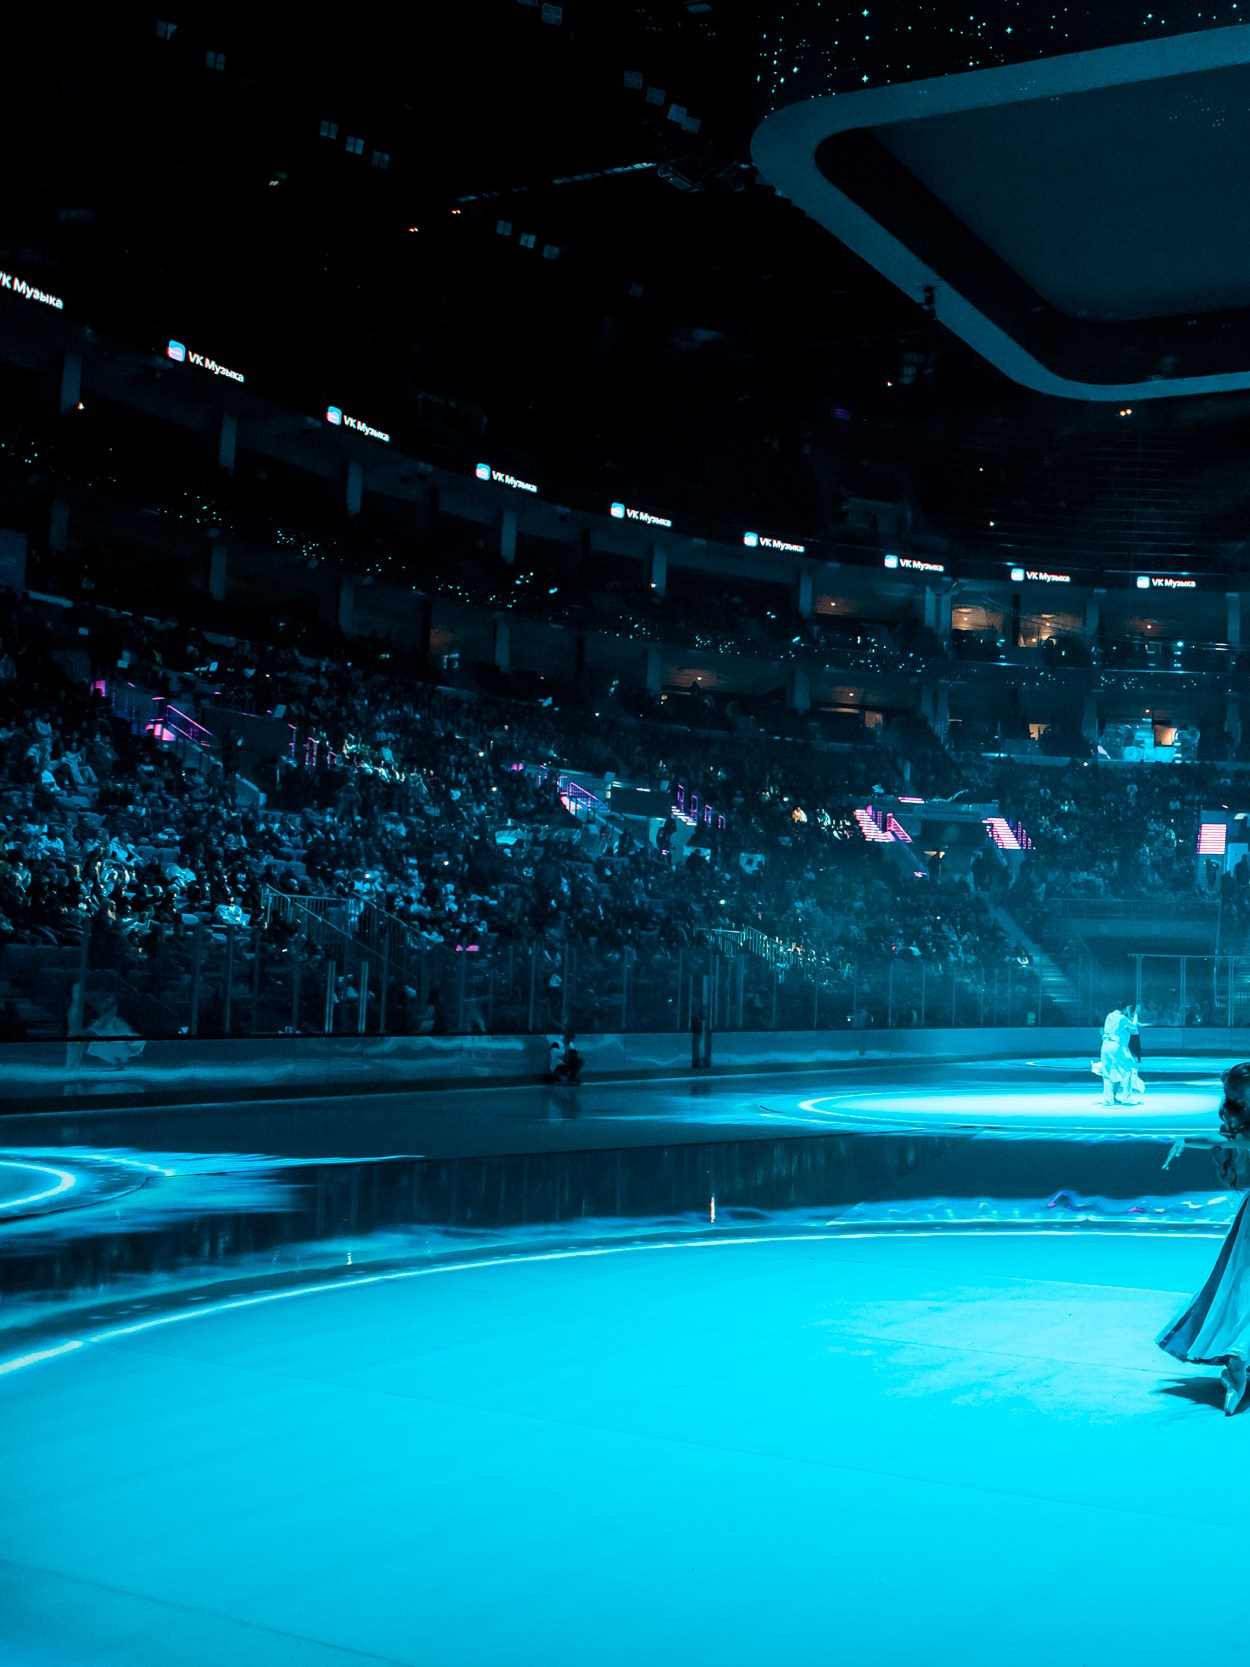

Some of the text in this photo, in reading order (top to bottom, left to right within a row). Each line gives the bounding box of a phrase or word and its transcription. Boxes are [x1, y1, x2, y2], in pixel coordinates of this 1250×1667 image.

[13, 277, 64, 310] Музыка
[188, 351, 245, 383] VK Музыка
[343, 415, 390, 442] VK Музыка
[491, 471, 538, 493] VK Музыка
[626, 509, 672, 528] VK Музыка
[759, 537, 772, 548] VK
[899, 559, 912, 568] VK
[1025, 571, 1038, 581] VK
[1151, 579, 1164, 587] VK
